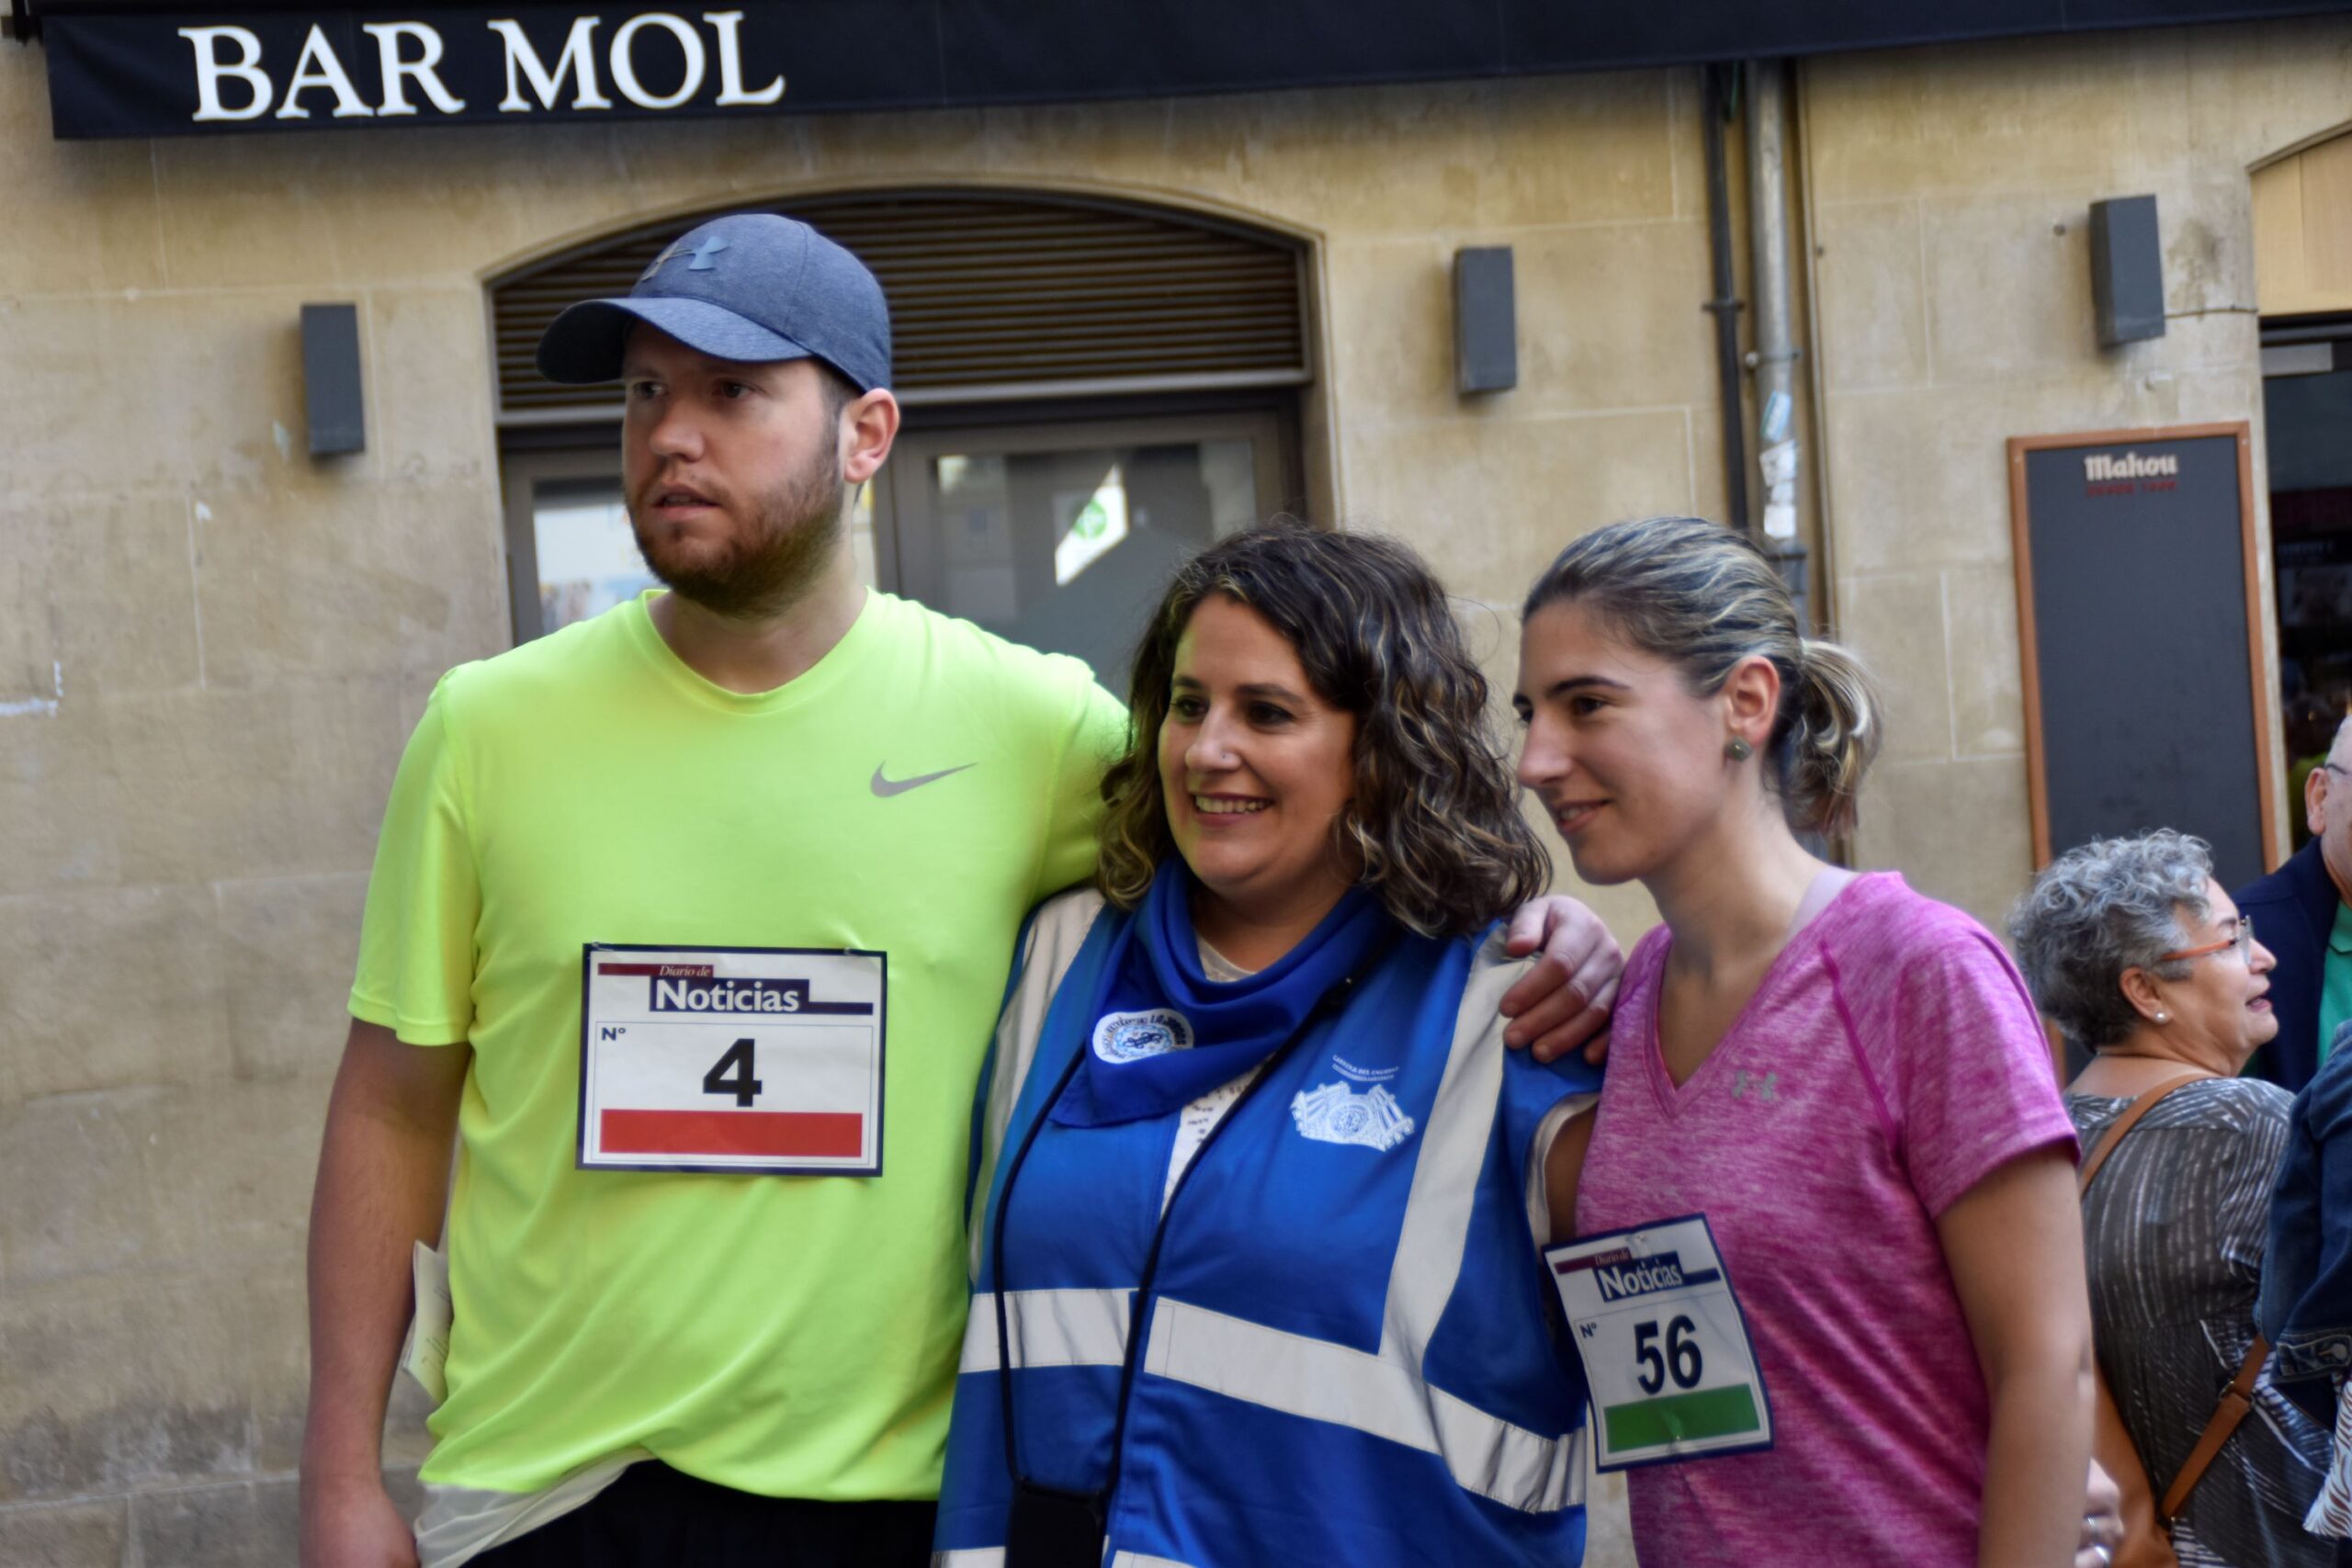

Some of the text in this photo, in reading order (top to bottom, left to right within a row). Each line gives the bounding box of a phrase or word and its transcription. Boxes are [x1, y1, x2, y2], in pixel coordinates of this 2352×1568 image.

[178, 11, 786, 121] BAR MOL
[2085, 450, 2178, 481] Mahou
[660, 965, 711, 977] Diario de
[656, 979, 799, 1011] Noticias
[703, 1038, 763, 1107] 4
[1598, 1258, 1684, 1299] Noticias
[1634, 1314, 1702, 1395] 56
